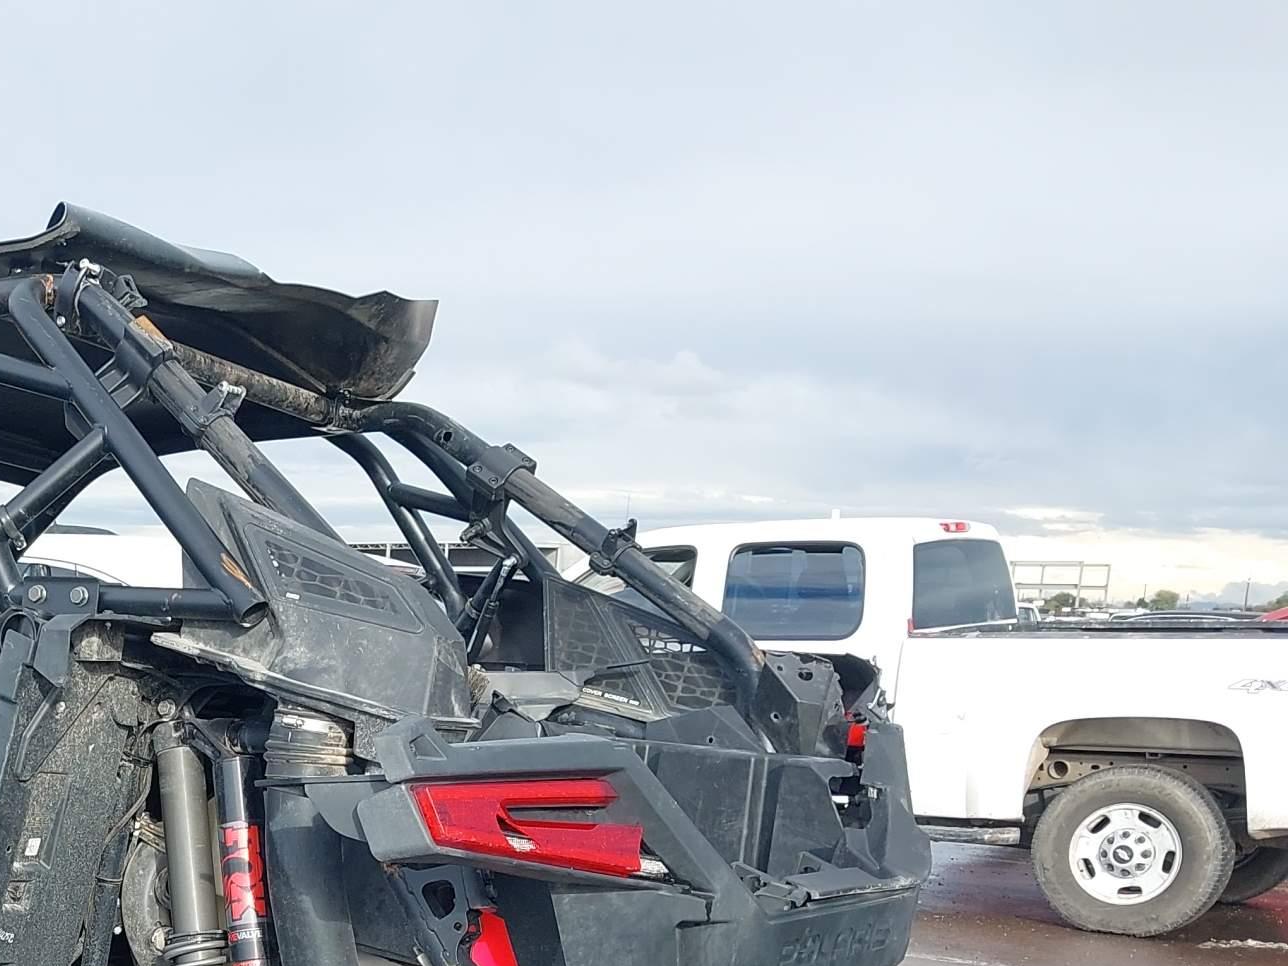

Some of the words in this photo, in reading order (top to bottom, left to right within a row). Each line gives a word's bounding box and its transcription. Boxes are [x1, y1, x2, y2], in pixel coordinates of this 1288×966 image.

[582, 687, 603, 697] COVER
[603, 692, 629, 703] SCREEN
[221, 824, 267, 922] FOX
